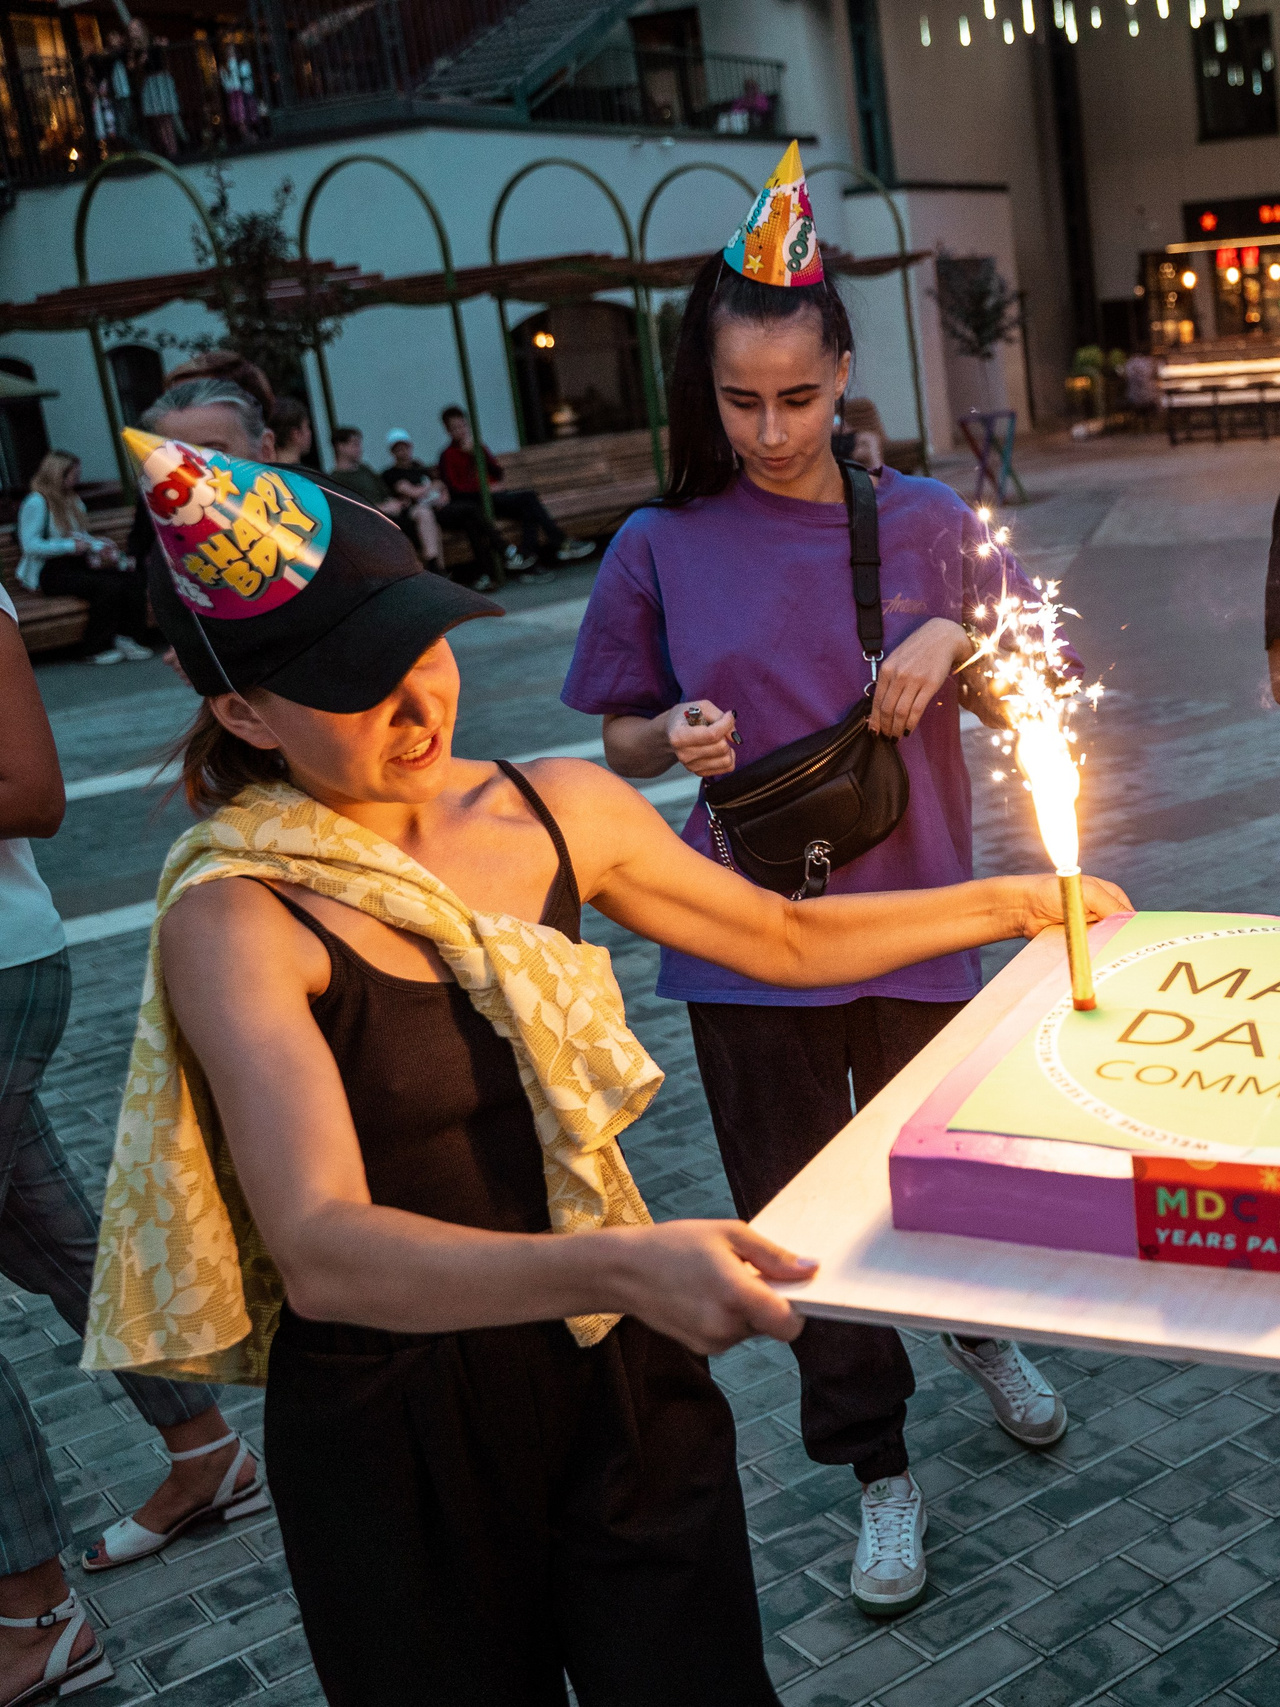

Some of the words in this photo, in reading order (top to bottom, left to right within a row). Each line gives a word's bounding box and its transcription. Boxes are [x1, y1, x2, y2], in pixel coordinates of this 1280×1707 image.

[222, 499, 316, 597] BDAY
[1110, 940, 1176, 969] WELCOME
[1185, 934, 1205, 942] TO
[1156, 1186, 1259, 1224] MDC
[1155, 1228, 1237, 1251] YEARS
